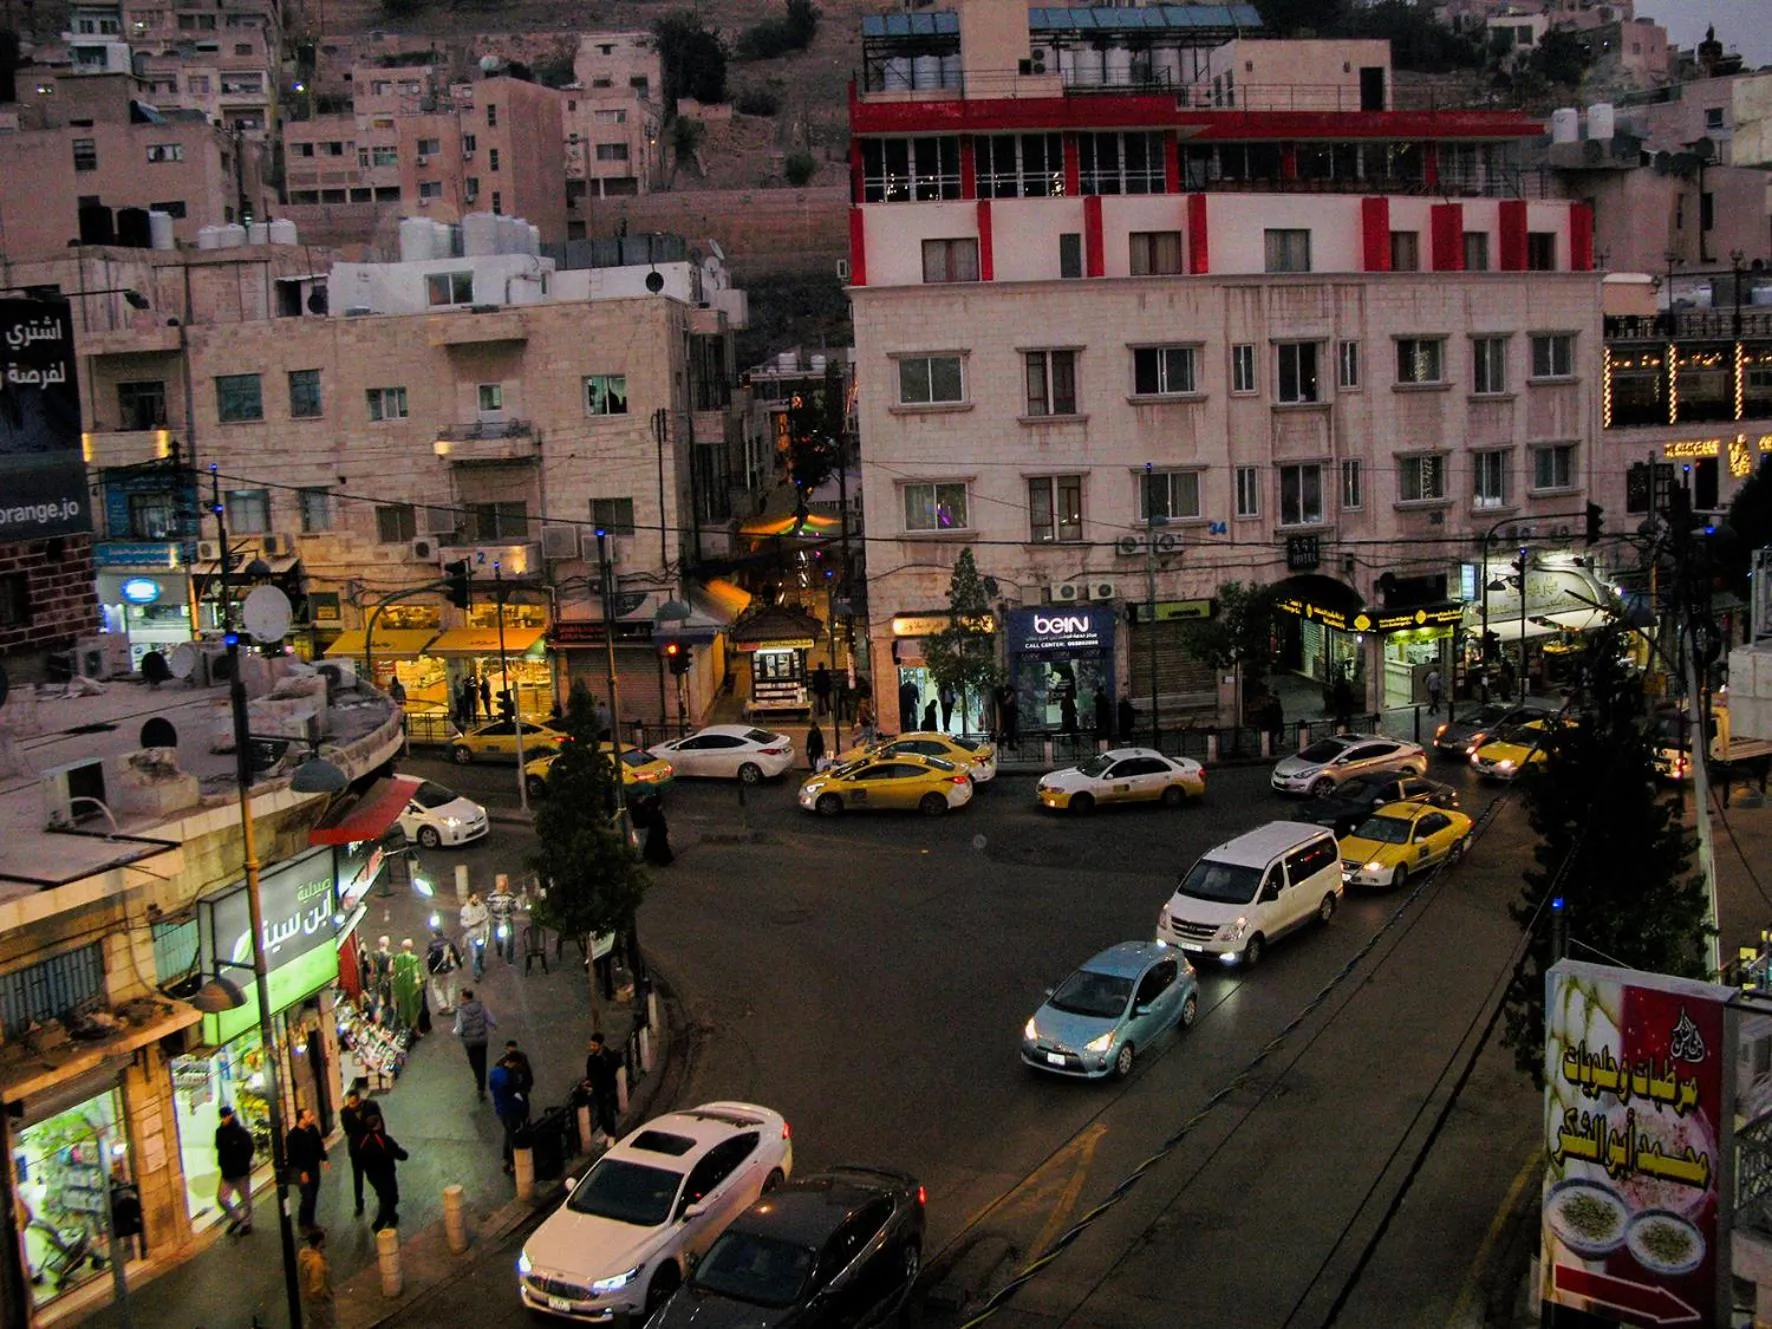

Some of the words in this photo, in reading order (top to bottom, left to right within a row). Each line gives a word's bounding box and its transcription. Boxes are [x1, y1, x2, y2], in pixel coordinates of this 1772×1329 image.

[6, 316, 62, 350] اشتري
[8, 361, 66, 390] لفرصة
[297, 878, 331, 904] صيدلية
[304, 888, 332, 936] ابن
[262, 911, 301, 953] سين
[1563, 1039, 1631, 1107] وحلويات
[1632, 1056, 1699, 1118] مرطبات
[1606, 1107, 1635, 1180] أبو
